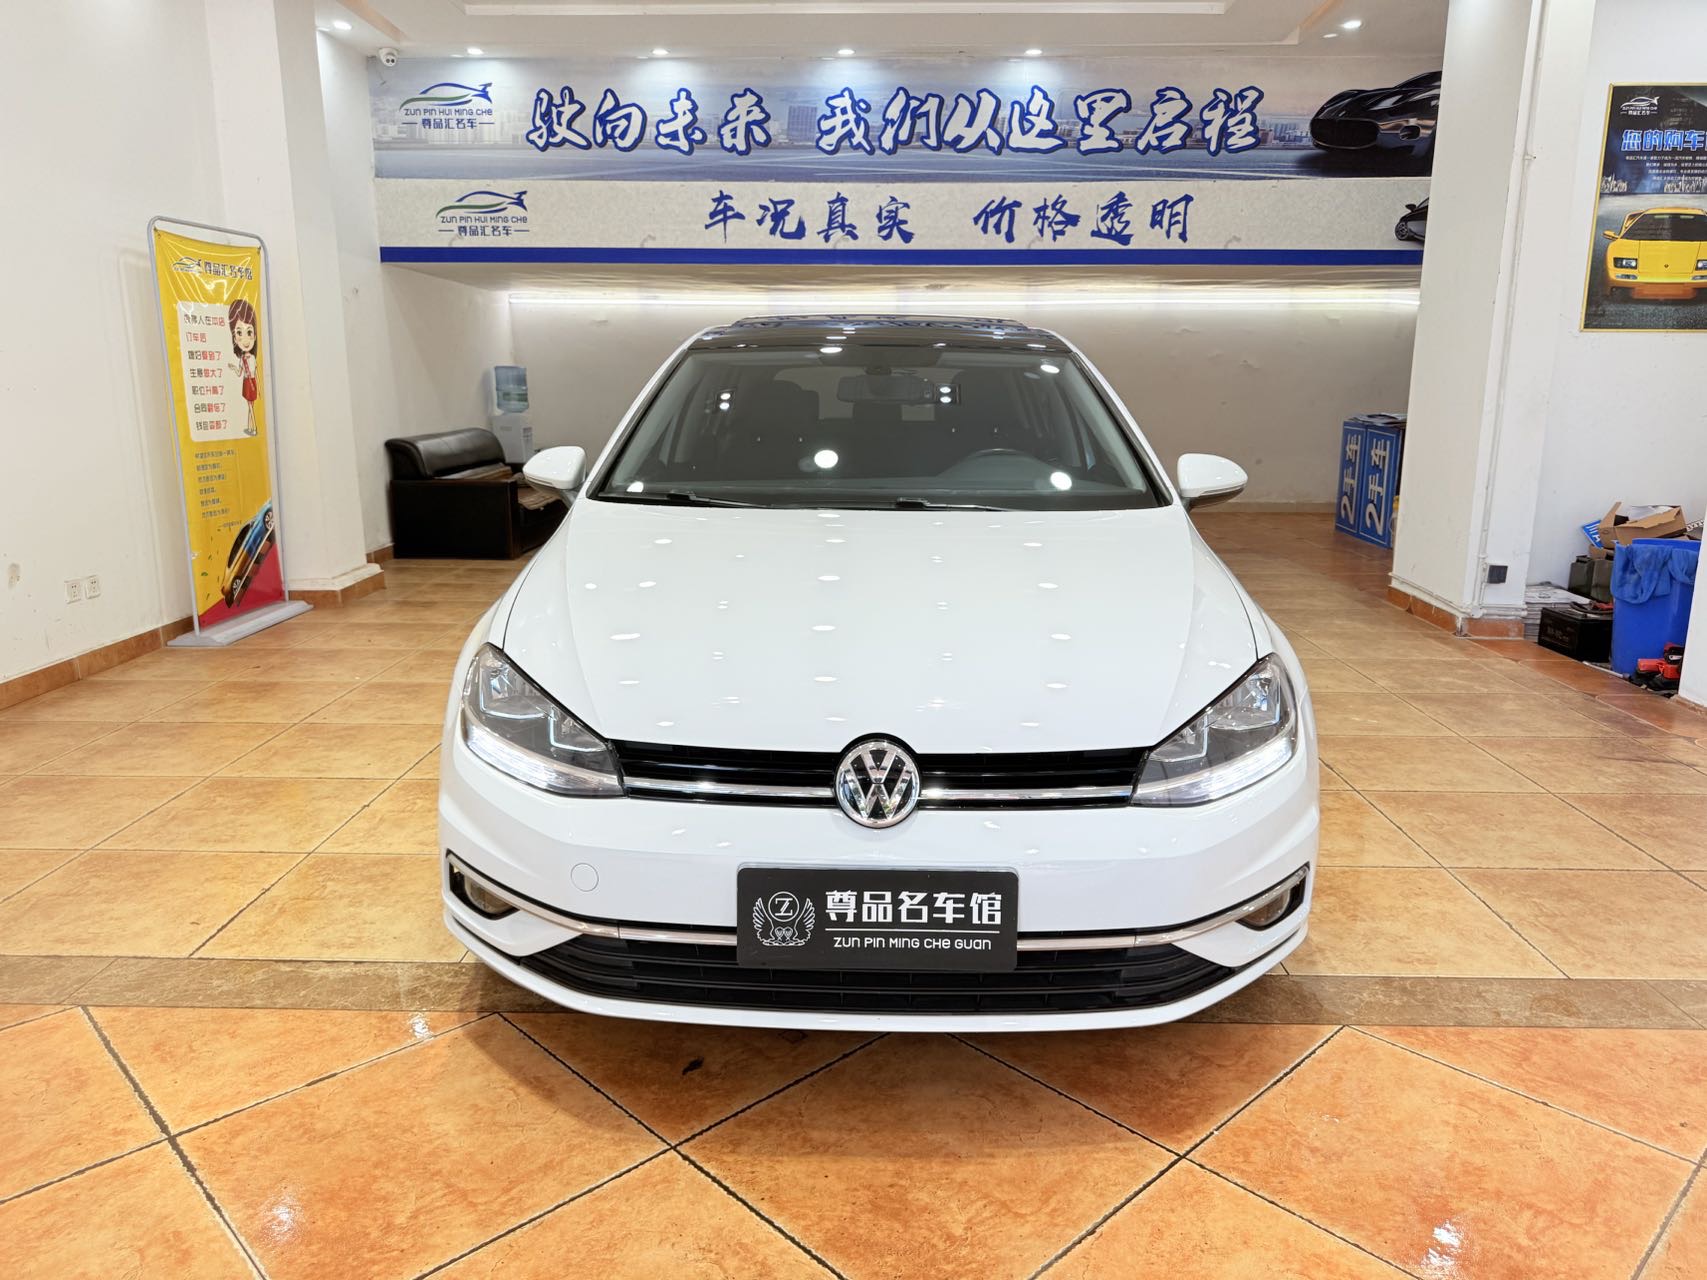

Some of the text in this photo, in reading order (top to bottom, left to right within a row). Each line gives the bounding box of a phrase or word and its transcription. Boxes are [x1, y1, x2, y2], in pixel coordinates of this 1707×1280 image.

[421, 118, 478, 130] 尊品汇名车
[526, 85, 1265, 156] 驶向未来 我们从这里启程
[1621, 129, 1707, 151] 您的购车
[457, 225, 513, 237] 尊品汇名车
[704, 190, 1195, 247] 车况真实 价格透明
[825, 890, 1002, 925] 尊品名车馆
